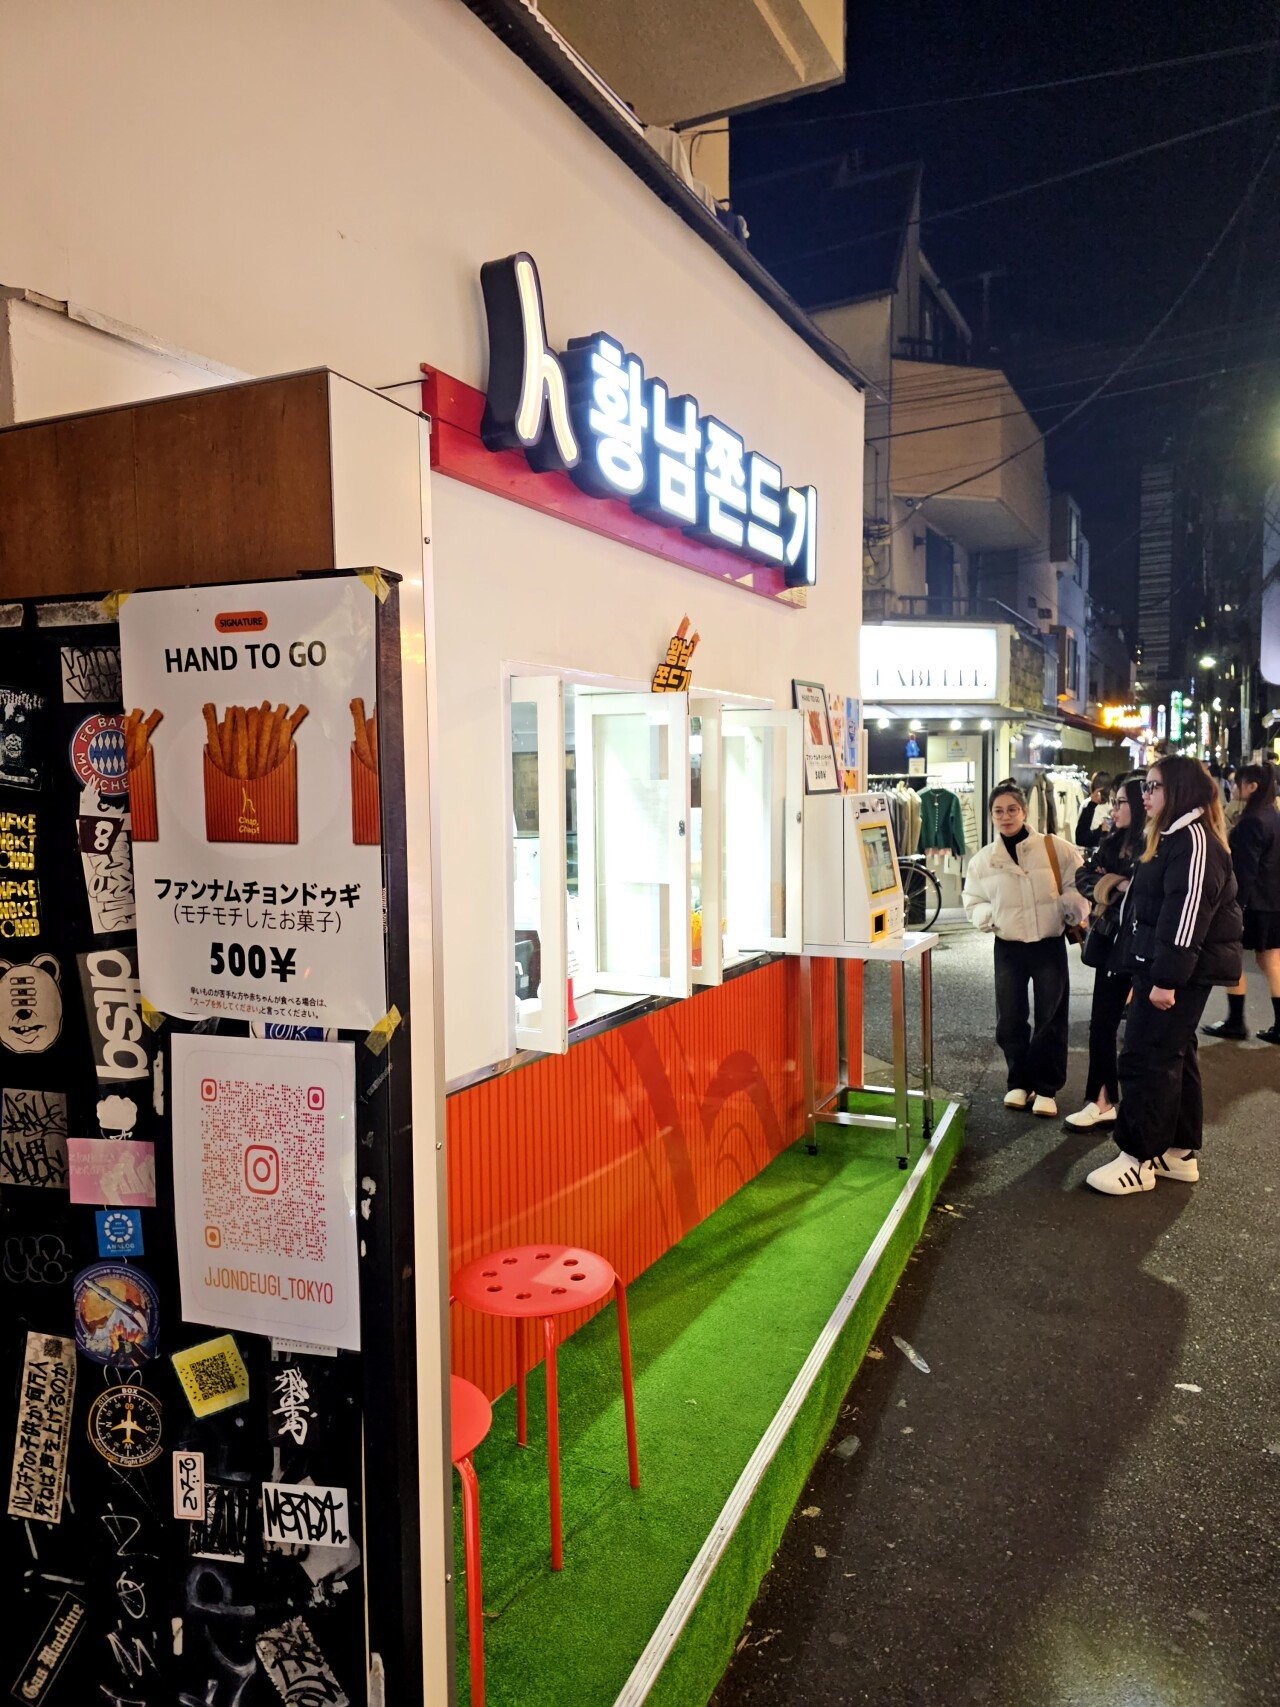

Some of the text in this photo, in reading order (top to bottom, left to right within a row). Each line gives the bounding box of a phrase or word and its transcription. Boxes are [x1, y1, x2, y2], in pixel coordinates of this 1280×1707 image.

[588, 336, 816, 585] 황남쫀드기
[219, 616, 263, 628] SIGNATURE
[164, 640, 327, 674] HAND TO GO
[79, 724, 96, 742] FC
[154, 878, 361, 909] ファンナムチョンドゥギ
[173, 903, 342, 934] (モチモチしたお菓子)
[210, 941, 297, 983] 500¥
[106, 1242, 135, 1251] ANALOG
[204, 1265, 333, 1305] JJONDEUGI_TOKYO
[121, 1387, 138, 1395] BOX
[119, 1456, 138, 1465] Flight
[138, 1445, 161, 1464] Academy
[37, 1603, 85, 1670] Machine
